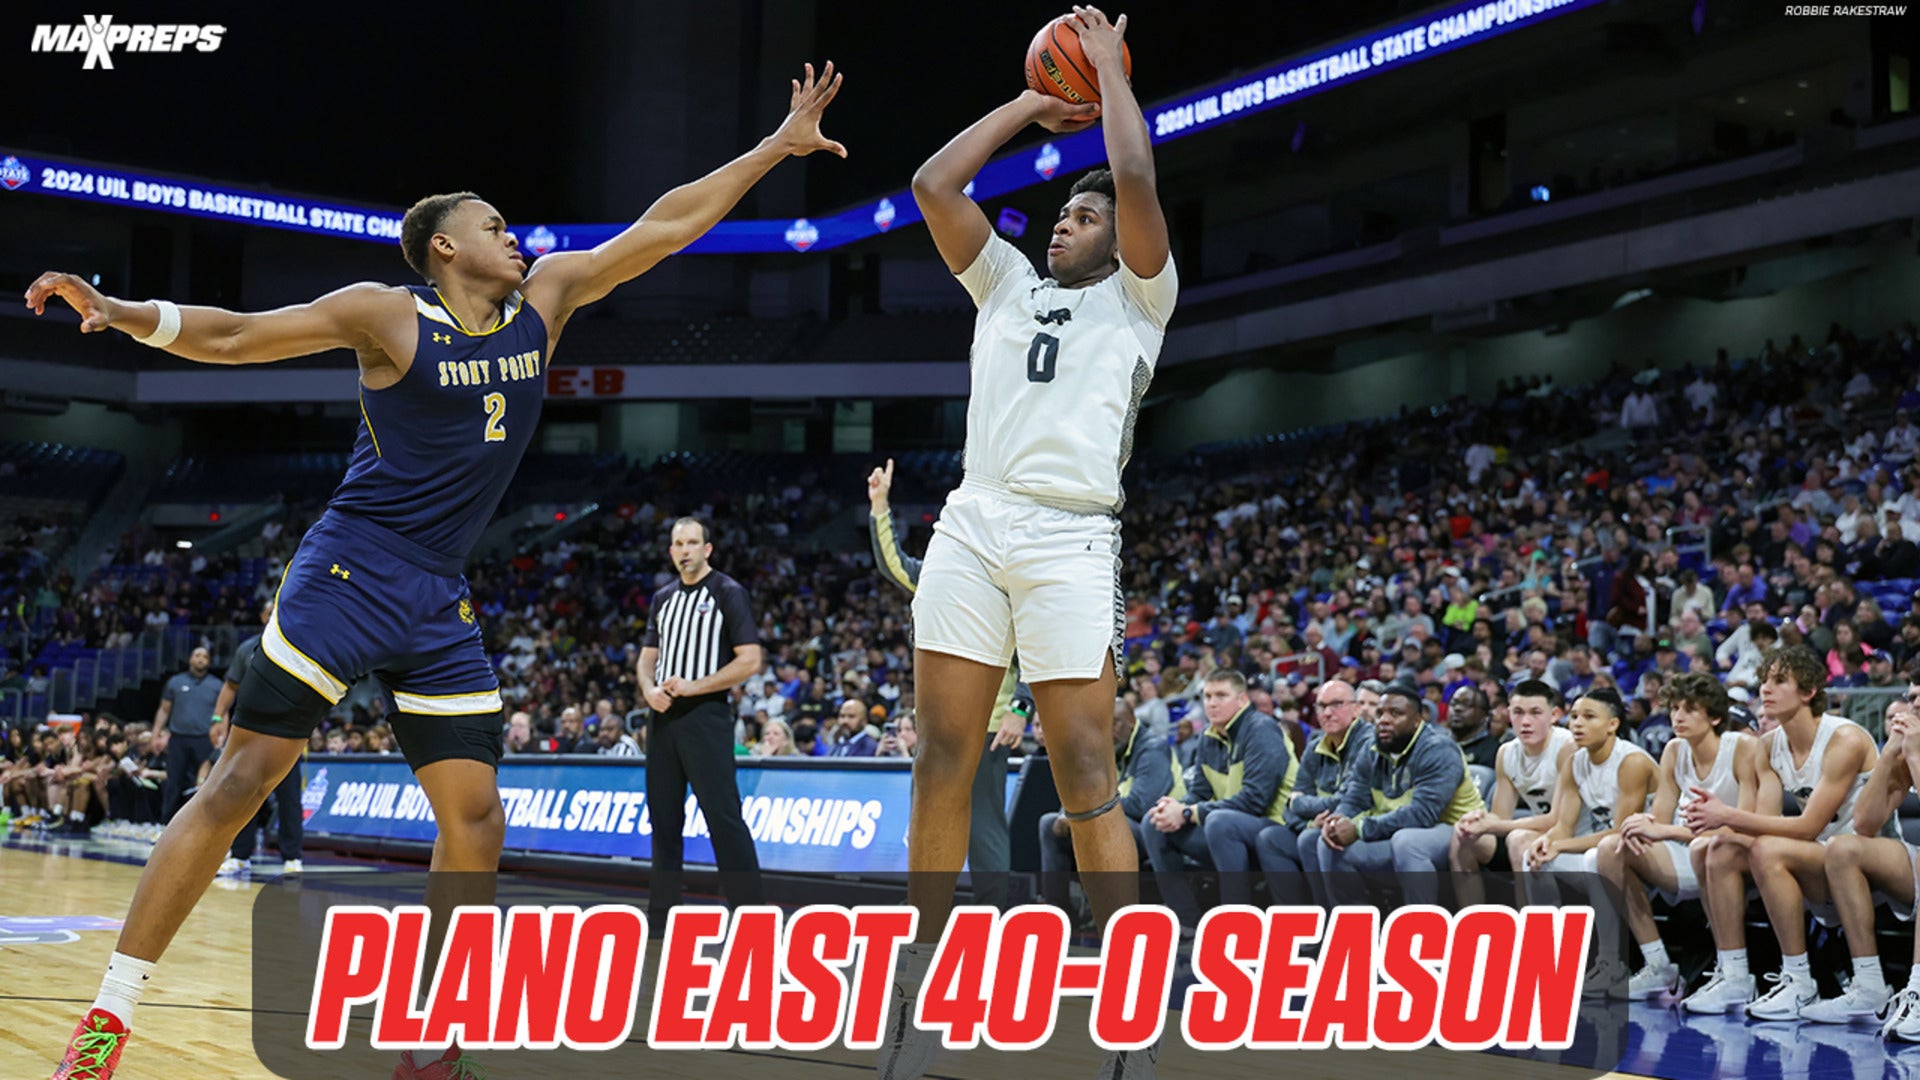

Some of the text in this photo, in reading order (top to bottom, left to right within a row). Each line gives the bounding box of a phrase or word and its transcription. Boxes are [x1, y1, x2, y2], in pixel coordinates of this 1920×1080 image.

[1155, 104, 1195, 136] 2024
[1194, 95, 1221, 123] UIL
[1221, 81, 1265, 115] BOYS
[1265, 45, 1372, 100] BASKETBALL
[1371, 26, 1427, 66] STATE
[41, 167, 95, 194] 2024
[96, 175, 131, 199] UIL
[131, 181, 187, 207] BOYS
[188, 189, 308, 226] BASKETBALL
[309, 207, 366, 234] STATE
[438, 350, 540, 387] STONY POINT
[1027, 332, 1060, 384] 0
[483, 392, 507, 442] 2
[329, 781, 376, 817] 2024
[368, 782, 401, 819] UIL
[563, 789, 645, 834] STATE
